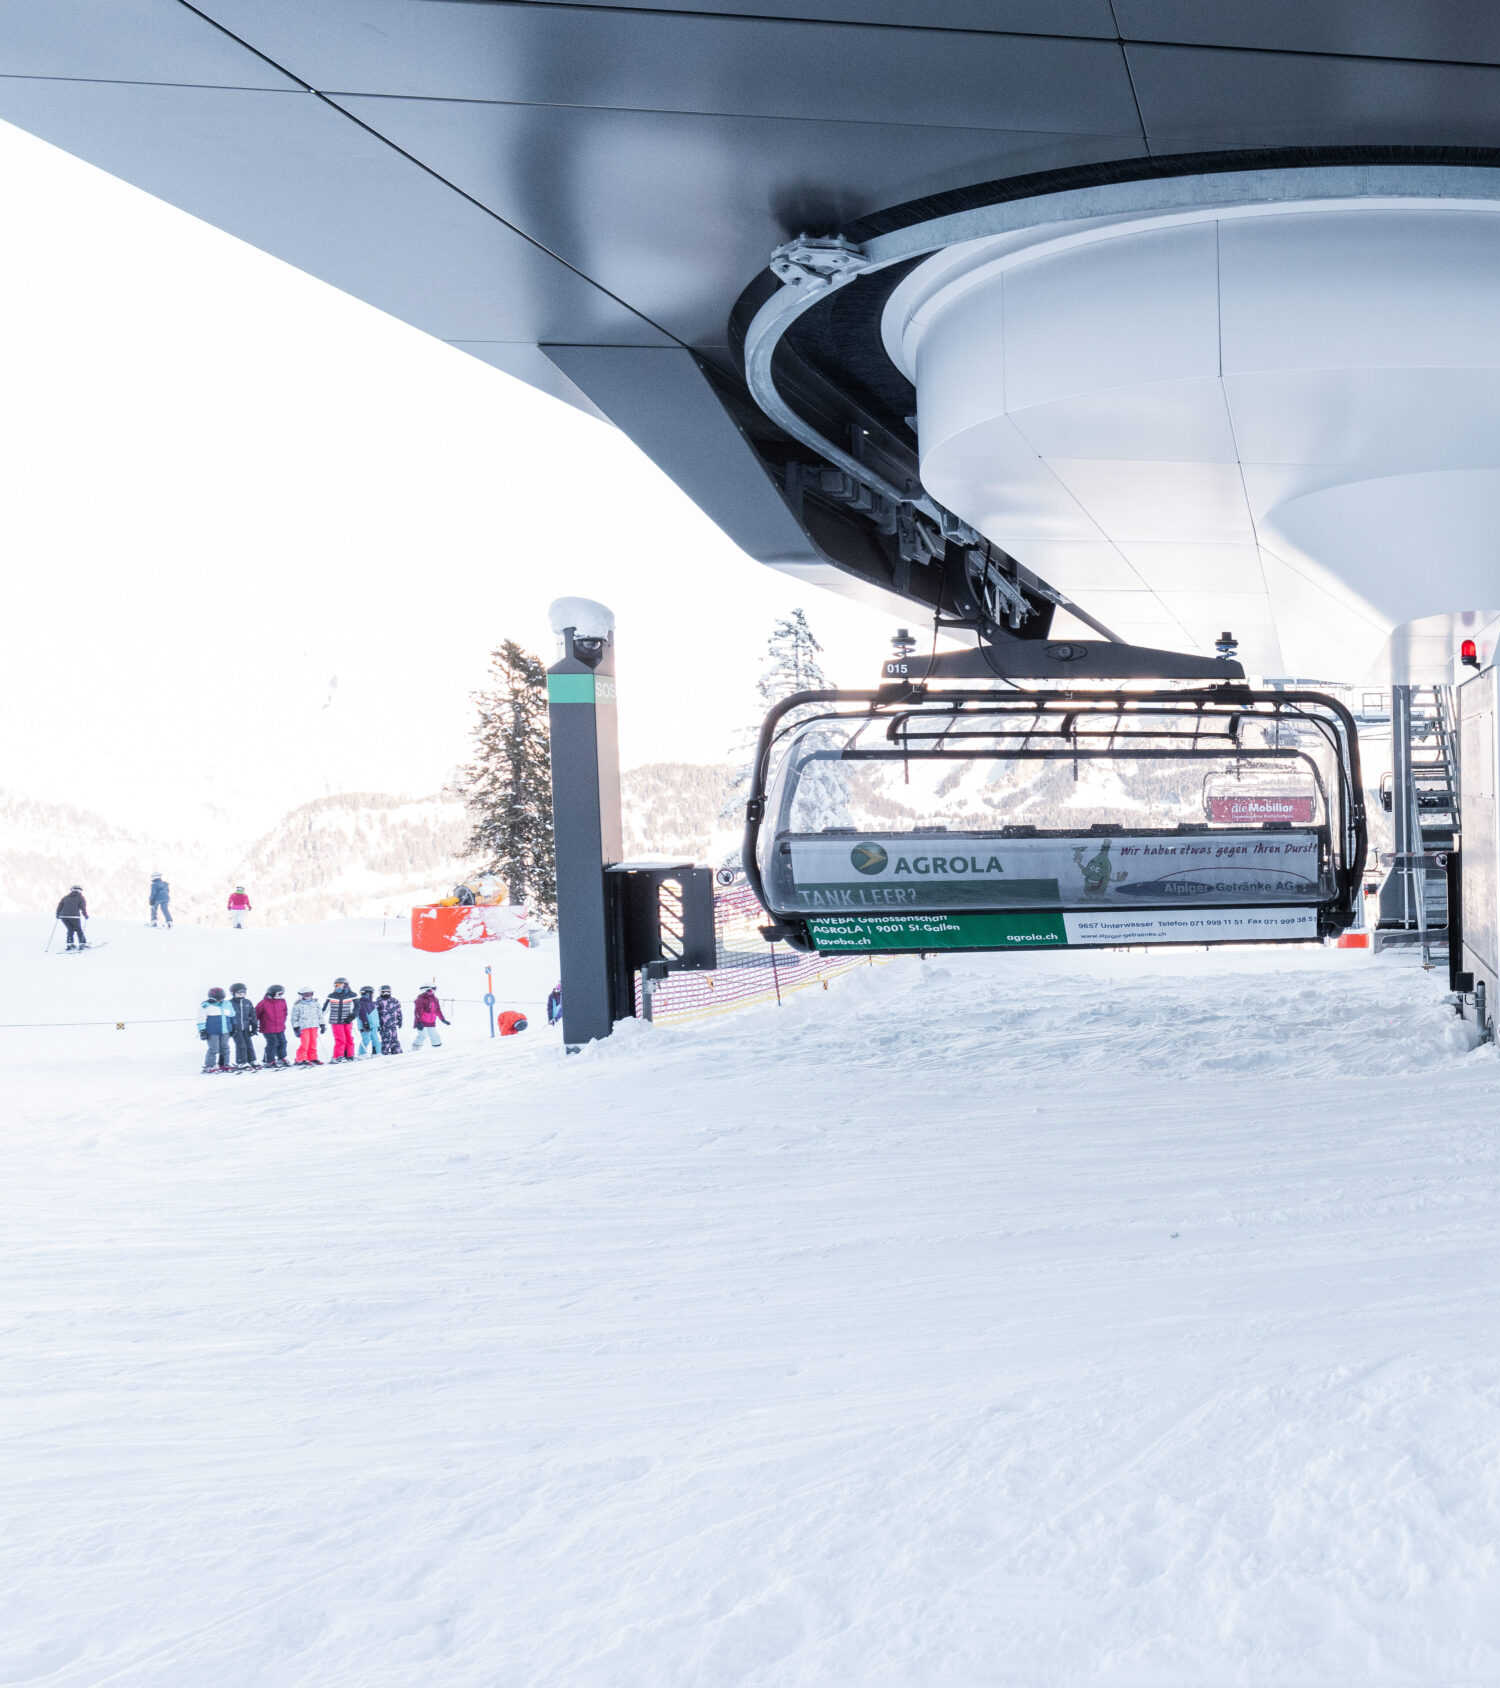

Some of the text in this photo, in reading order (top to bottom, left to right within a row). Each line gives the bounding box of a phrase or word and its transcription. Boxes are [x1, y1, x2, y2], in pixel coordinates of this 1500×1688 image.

[887, 664, 908, 673] 015
[596, 682, 616, 698] SOS
[1232, 803, 1294, 813] die Mobiliar
[1120, 842, 1318, 858] Wir haben etwas gegen Ihren Durst!
[894, 856, 1004, 874] AGROLA
[1164, 881, 1294, 894] Alpiger Getränke AG
[798, 888, 917, 906] TANK LEER?
[813, 925, 864, 934] AGROLA
[876, 924, 904, 932] 9001
[908, 924, 960, 932] St.Gallen
[1006, 933, 1058, 942] agrola.ch
